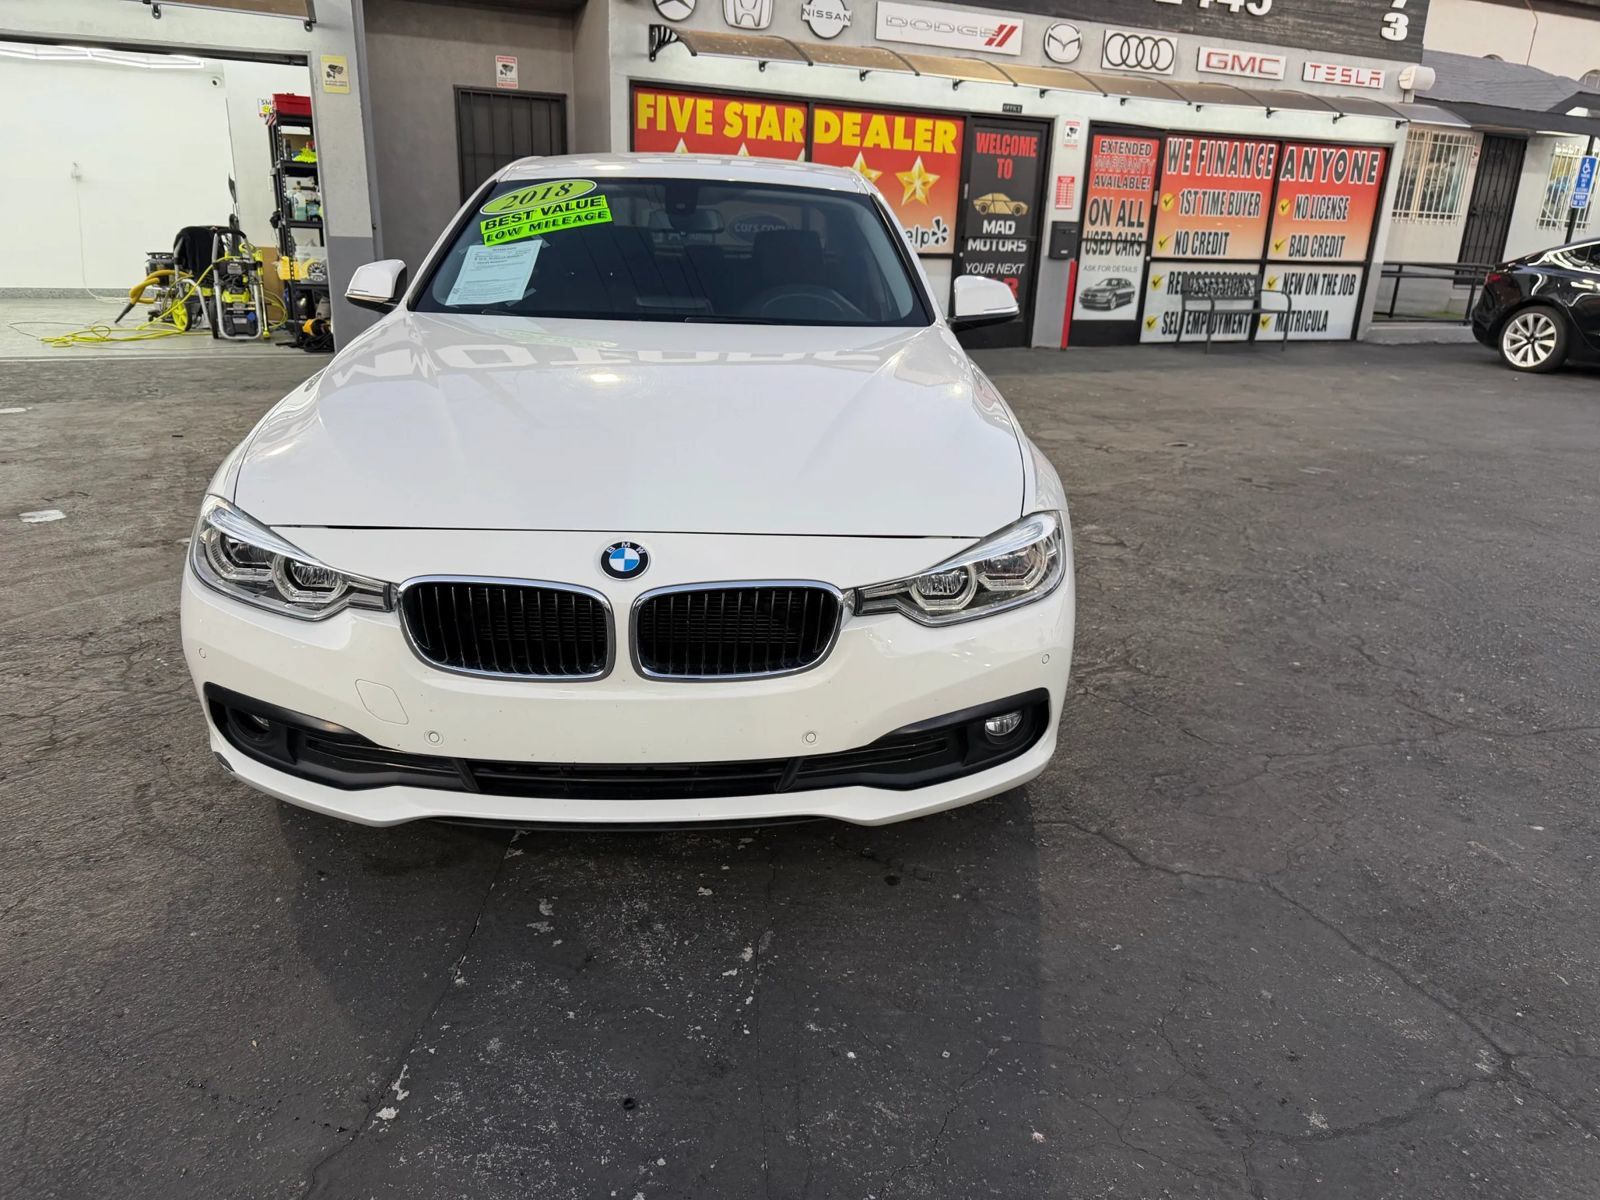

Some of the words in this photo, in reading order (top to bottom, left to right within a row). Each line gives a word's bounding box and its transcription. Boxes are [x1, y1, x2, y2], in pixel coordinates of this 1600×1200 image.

[802, 8, 852, 23] NISSAN
[886, 16, 998, 37] DODGE
[1206, 52, 1281, 75] GMC
[1310, 64, 1381, 86] TESLA
[637, 94, 713, 135] FIVE
[723, 101, 804, 143] STAR
[814, 108, 957, 154] DEALER
[976, 132, 1038, 157] WELCOME
[1100, 140, 1152, 156] EXTENDED
[997, 158, 1013, 179] TO
[1166, 138, 1194, 175] WE
[1195, 139, 1276, 180] FINANCE
[1280, 146, 1380, 185] ANYONE
[1094, 174, 1151, 190] AVAILABLE!
[499, 182, 573, 210] 2018
[1179, 189, 1199, 216] 1ST
[1200, 190, 1227, 216] TIME
[1227, 192, 1261, 217] BUYER
[1294, 195, 1310, 220] NO
[1310, 195, 1349, 221] LICENSE
[484, 210, 536, 231] BEST
[540, 197, 602, 216] VALUE
[1088, 197, 1113, 227] ON
[1115, 199, 1145, 228] ALL
[486, 226, 523, 243] LOW
[528, 210, 609, 232] MILEAGE
[905, 226, 930, 248] elp
[983, 219, 1016, 236] MAD
[967, 238, 1028, 253] MOTORS
[1085, 230, 1113, 256] USED
[1115, 231, 1143, 257] CARS
[1173, 230, 1189, 255] NO
[1191, 230, 1230, 256] CREDIT
[1288, 234, 1309, 258] BAD
[1310, 235, 1346, 258] CREDIT
[965, 262, 996, 274] YOUR
[996, 263, 1025, 275] NEXT
[1112, 265, 1138, 273] DETAILS
[1282, 272, 1306, 296] NEW
[1305, 273, 1320, 296] ON
[1320, 273, 1339, 296] THE
[1338, 273, 1357, 296] JOB
[1162, 310, 1184, 335] SEL
[1185, 311, 1251, 335] EMPOYMENT
[606, 541, 646, 555] BMW
